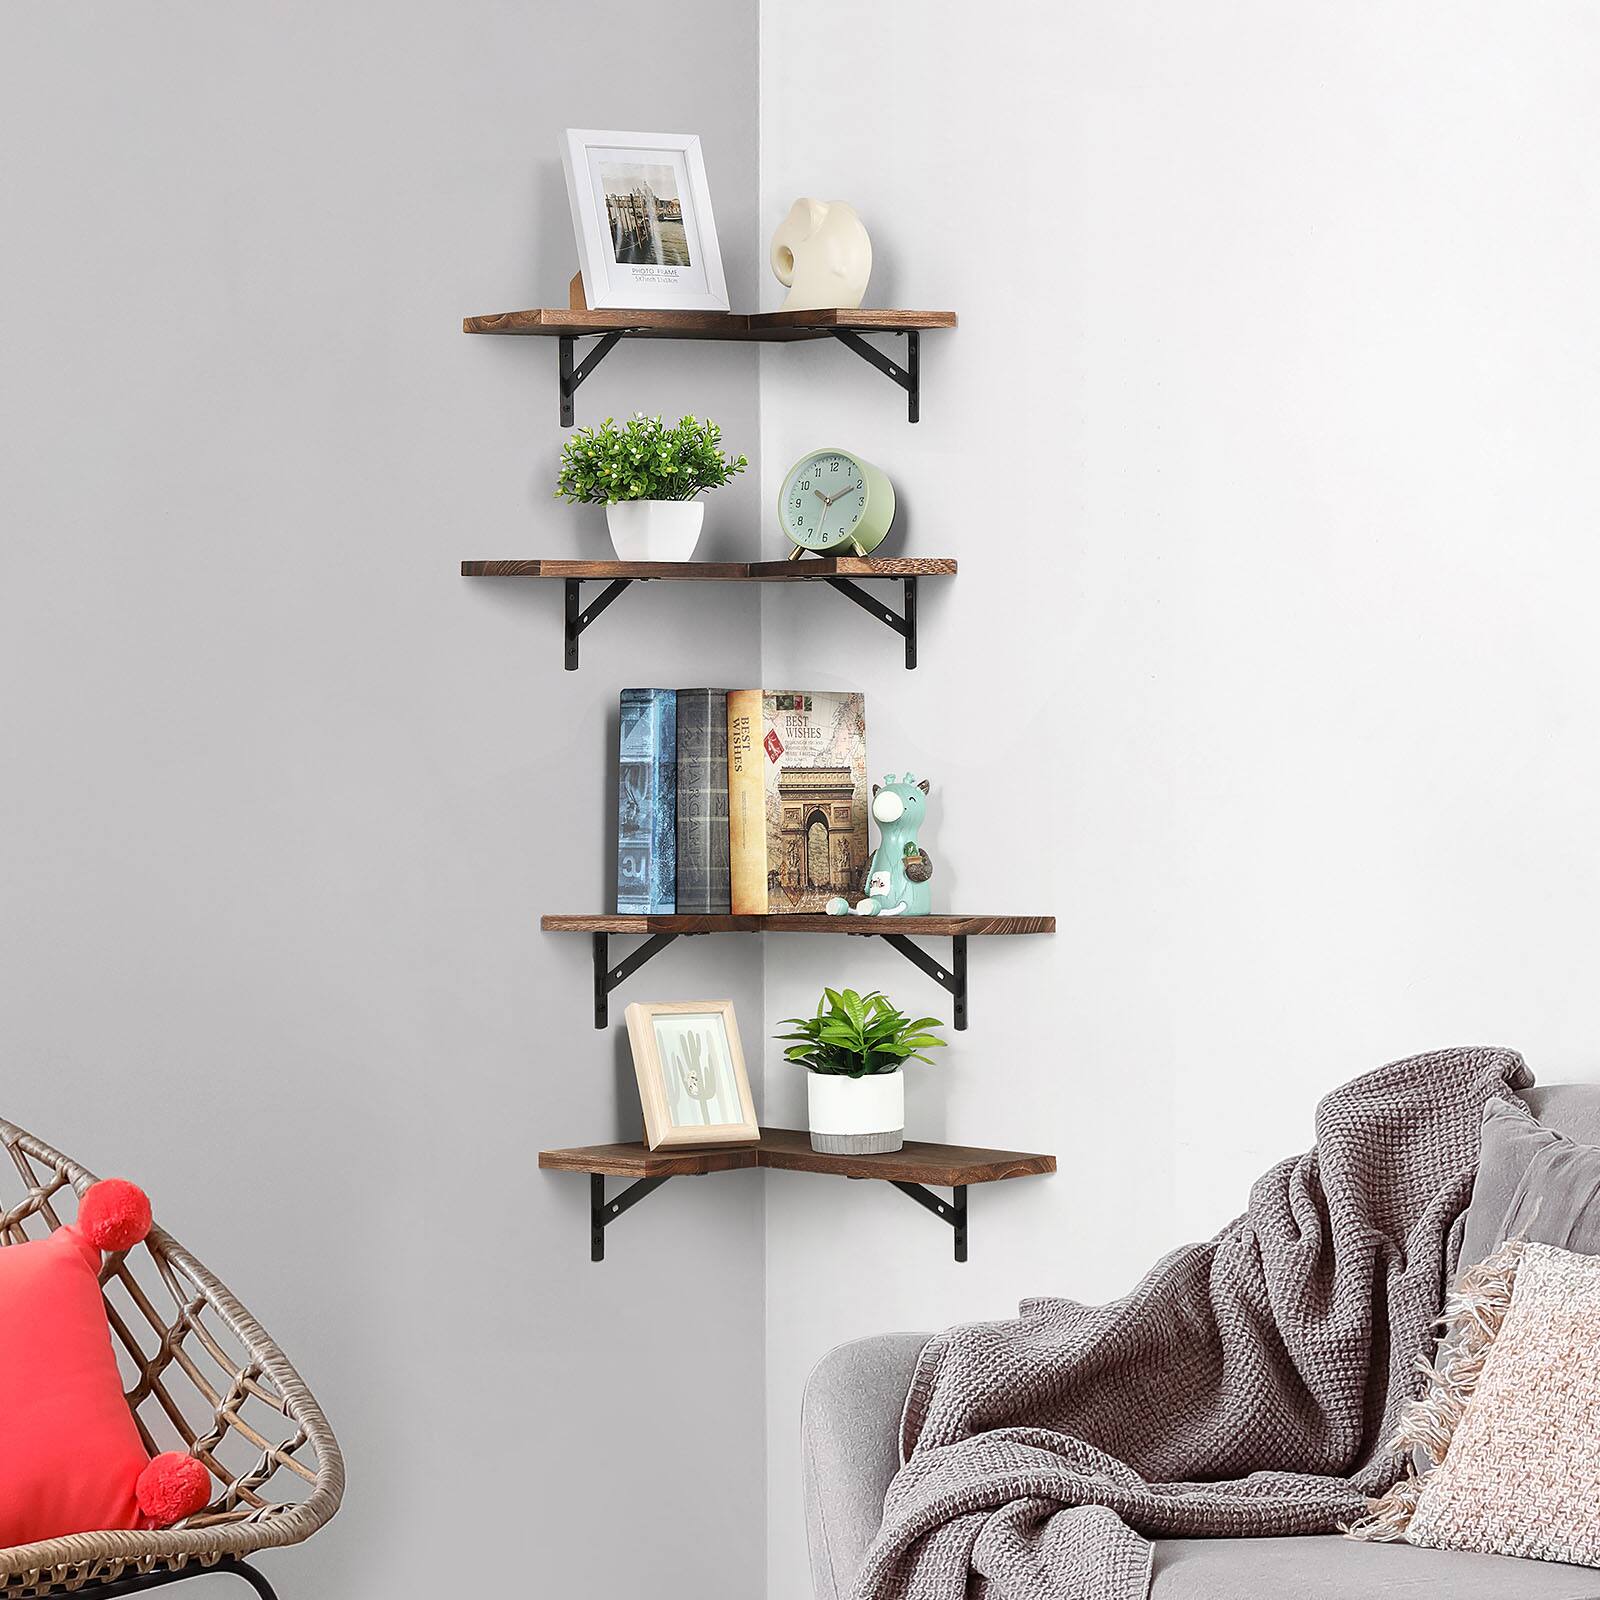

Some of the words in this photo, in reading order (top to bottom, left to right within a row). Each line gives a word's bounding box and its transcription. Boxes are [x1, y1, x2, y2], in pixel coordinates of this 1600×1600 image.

[830, 462, 839, 472] 12
[815, 468, 822, 477] 11
[801, 480, 810, 491] 10
[856, 479, 863, 489] 2
[795, 499, 802, 508] 9
[858, 497, 865, 507] 3
[797, 516, 804, 526] 8
[807, 528, 814, 538] 7
[838, 528, 845, 537] 5
[822, 533, 829, 543] 6
[785, 715, 809, 727] BEST
[740, 717, 751, 752] BEST
[785, 727, 822, 739] WISHES
[732, 718, 743, 773] WISHES
